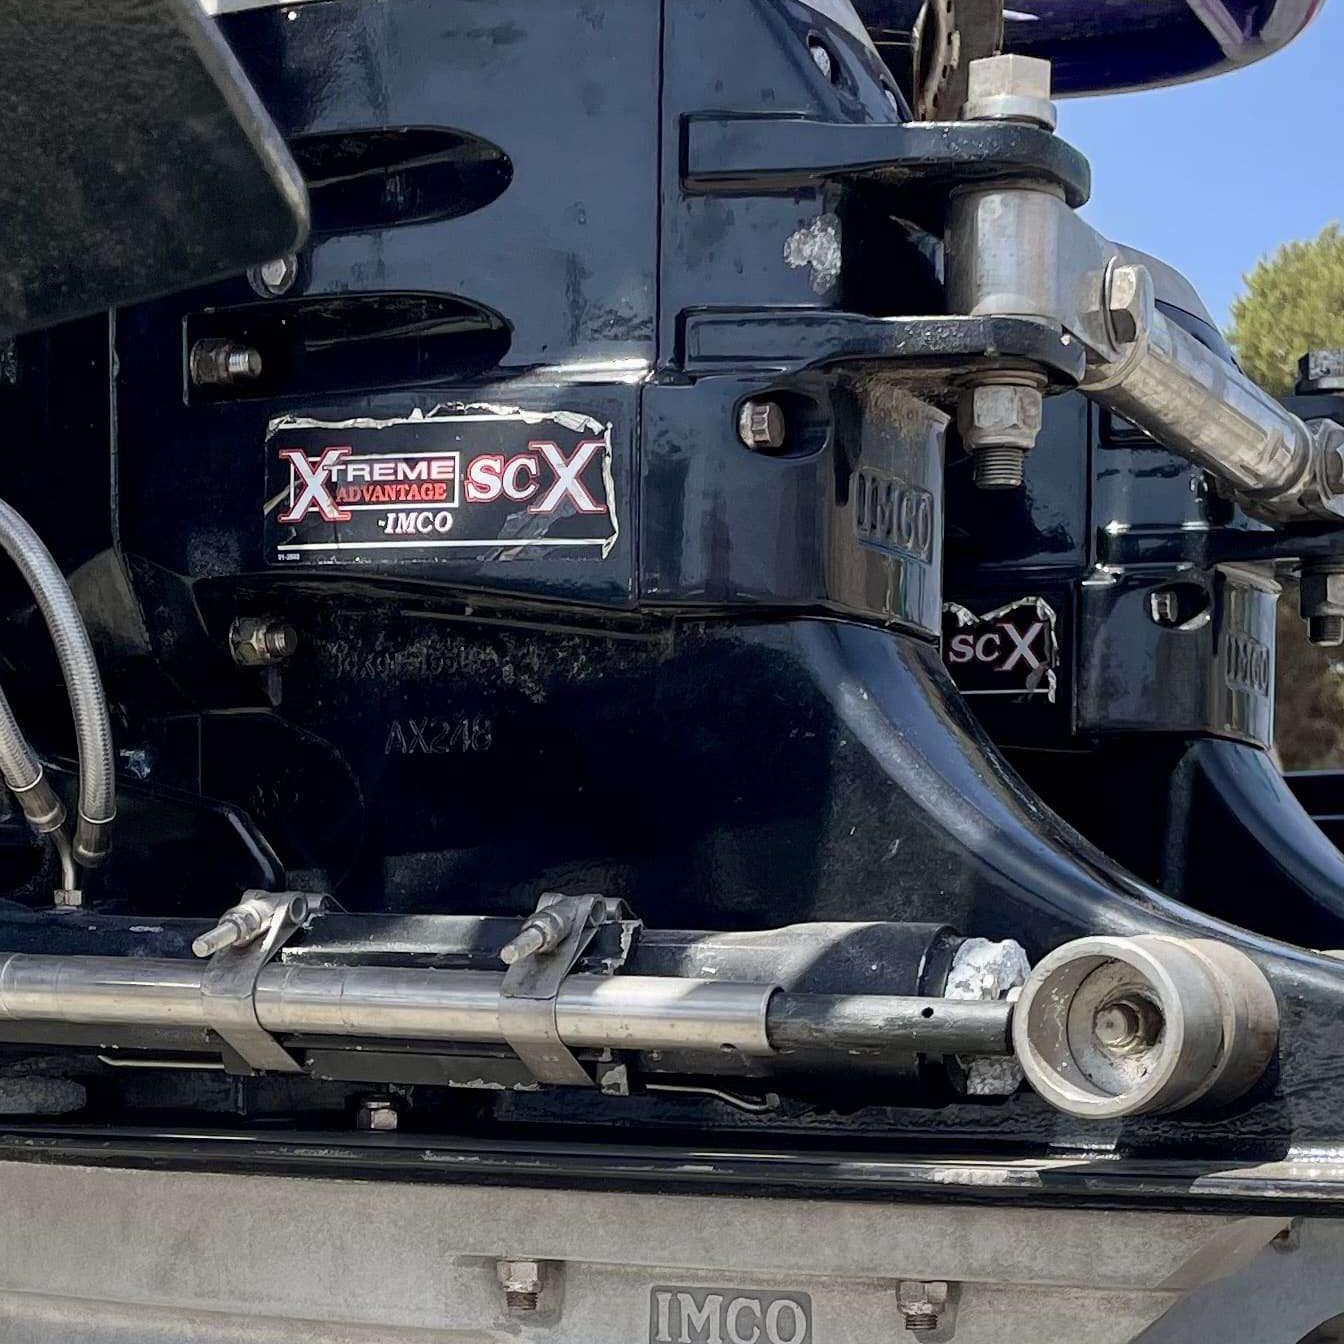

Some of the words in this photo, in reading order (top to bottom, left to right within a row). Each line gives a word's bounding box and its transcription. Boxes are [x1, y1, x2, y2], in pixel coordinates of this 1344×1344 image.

[279, 447, 455, 523] XTREME
[336, 482, 448, 503] ADVANTAGE
[465, 442, 607, 514] SCX
[384, 511, 454, 534] IMCO
[858, 474, 932, 556] IMCO
[948, 622, 1044, 671] SCX
